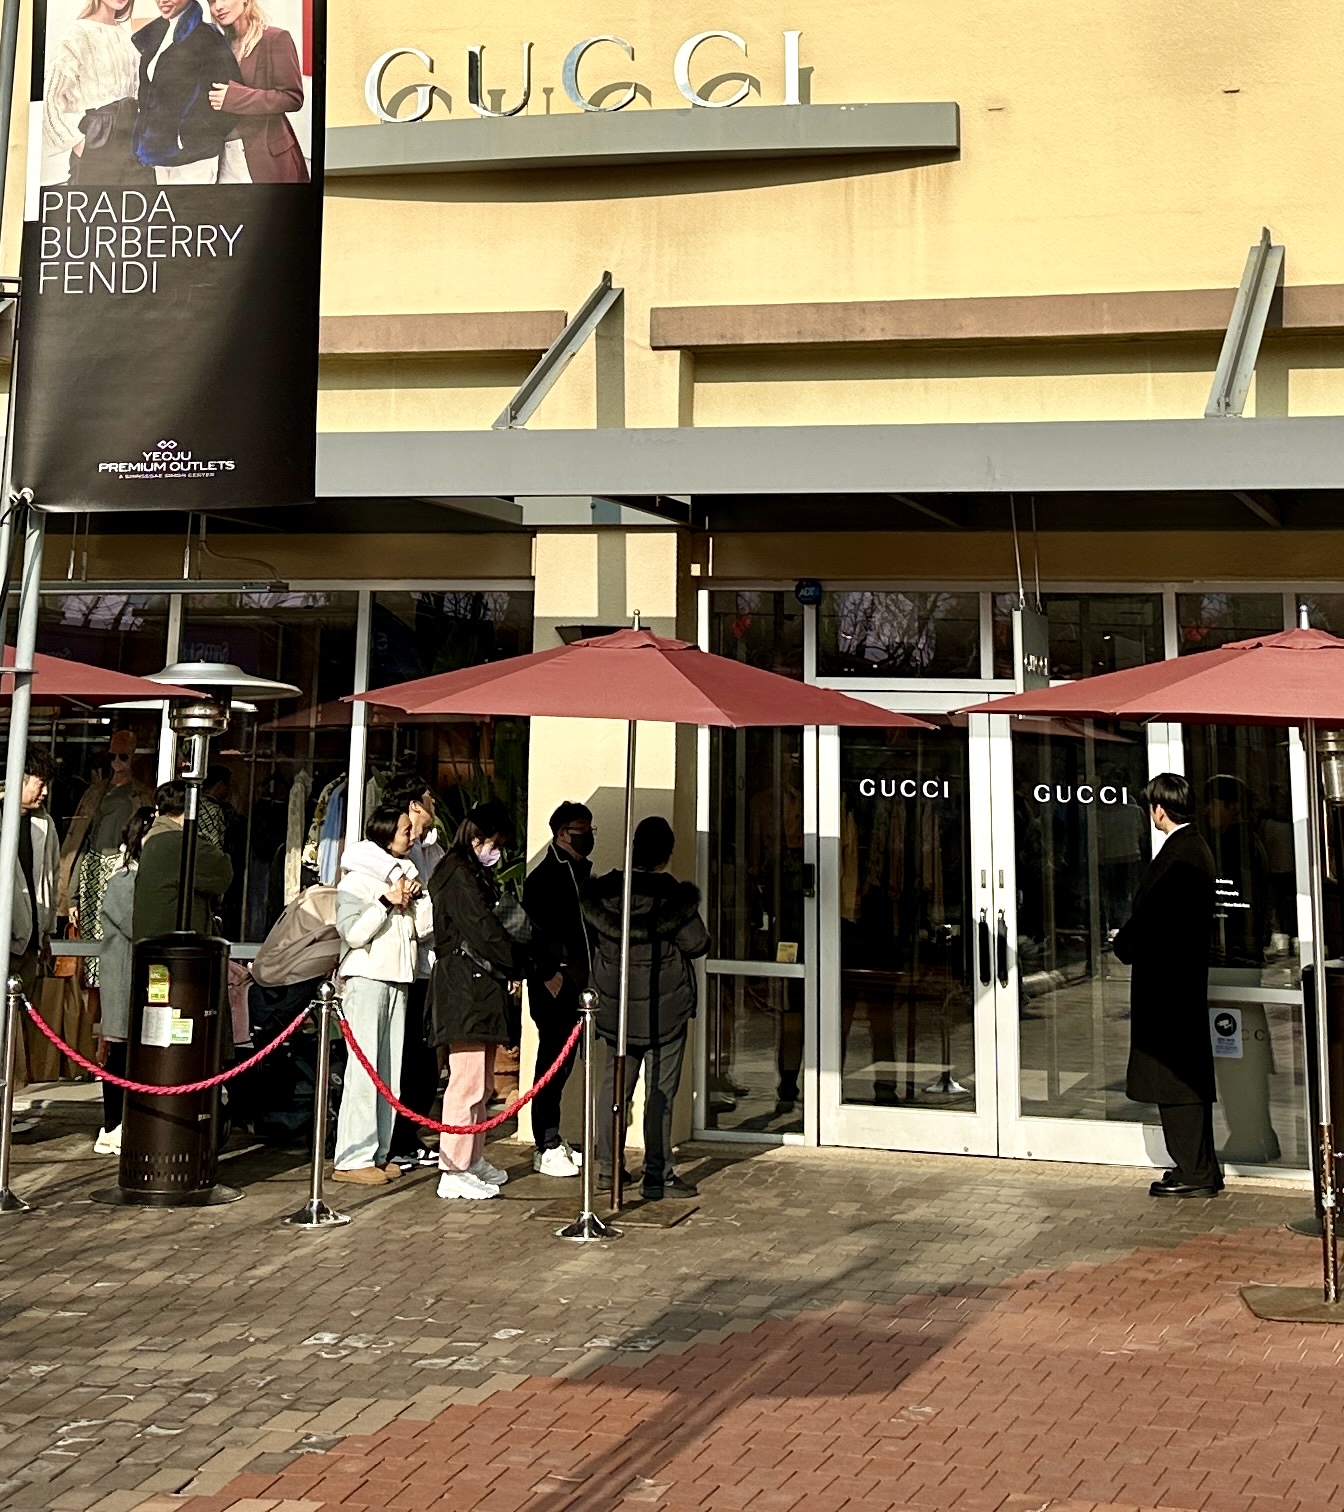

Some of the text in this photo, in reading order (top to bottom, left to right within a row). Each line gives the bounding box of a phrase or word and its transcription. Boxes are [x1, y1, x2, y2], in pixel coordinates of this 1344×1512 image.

[364, 29, 803, 123] GUCCI
[42, 190, 176, 223] PRADA
[40, 224, 244, 259] BURBERRY
[39, 260, 157, 294] FENDI
[98, 460, 236, 473] PREMIUM OUTLETS
[142, 451, 192, 462] YEOJU
[859, 778, 949, 799] GUCCI
[1033, 783, 1128, 805] GUCCI
